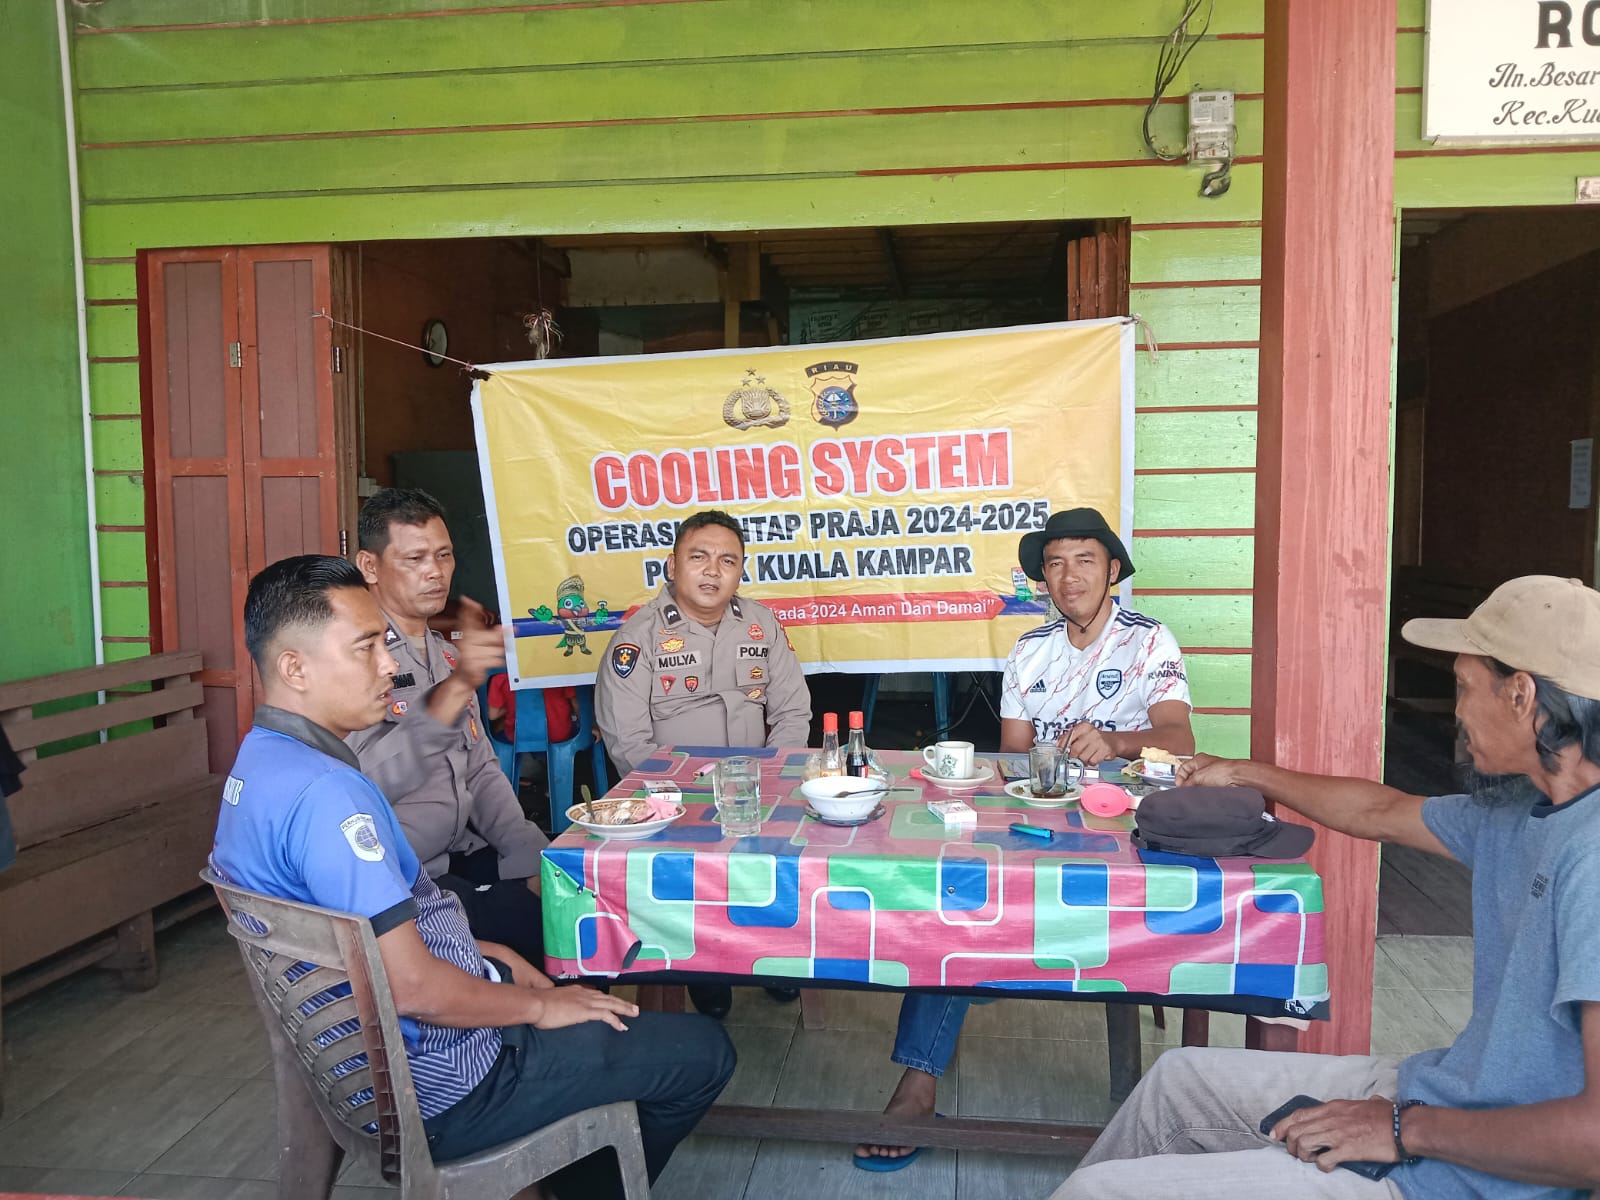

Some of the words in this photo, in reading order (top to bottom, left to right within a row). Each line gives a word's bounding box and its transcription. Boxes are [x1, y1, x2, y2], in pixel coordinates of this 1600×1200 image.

[811, 364, 853, 374] RIAU
[592, 443, 802, 510] COOLING
[811, 431, 1009, 497] SYSTEM
[809, 507, 900, 539] PRAJA
[907, 501, 1048, 534] 2024-2025
[757, 551, 849, 581] KUALA
[856, 547, 972, 577] KAMPAR
[811, 604, 847, 618] 2024
[851, 602, 896, 617] Aman
[901, 601, 932, 616] Dan
[658, 653, 697, 669] MULYA
